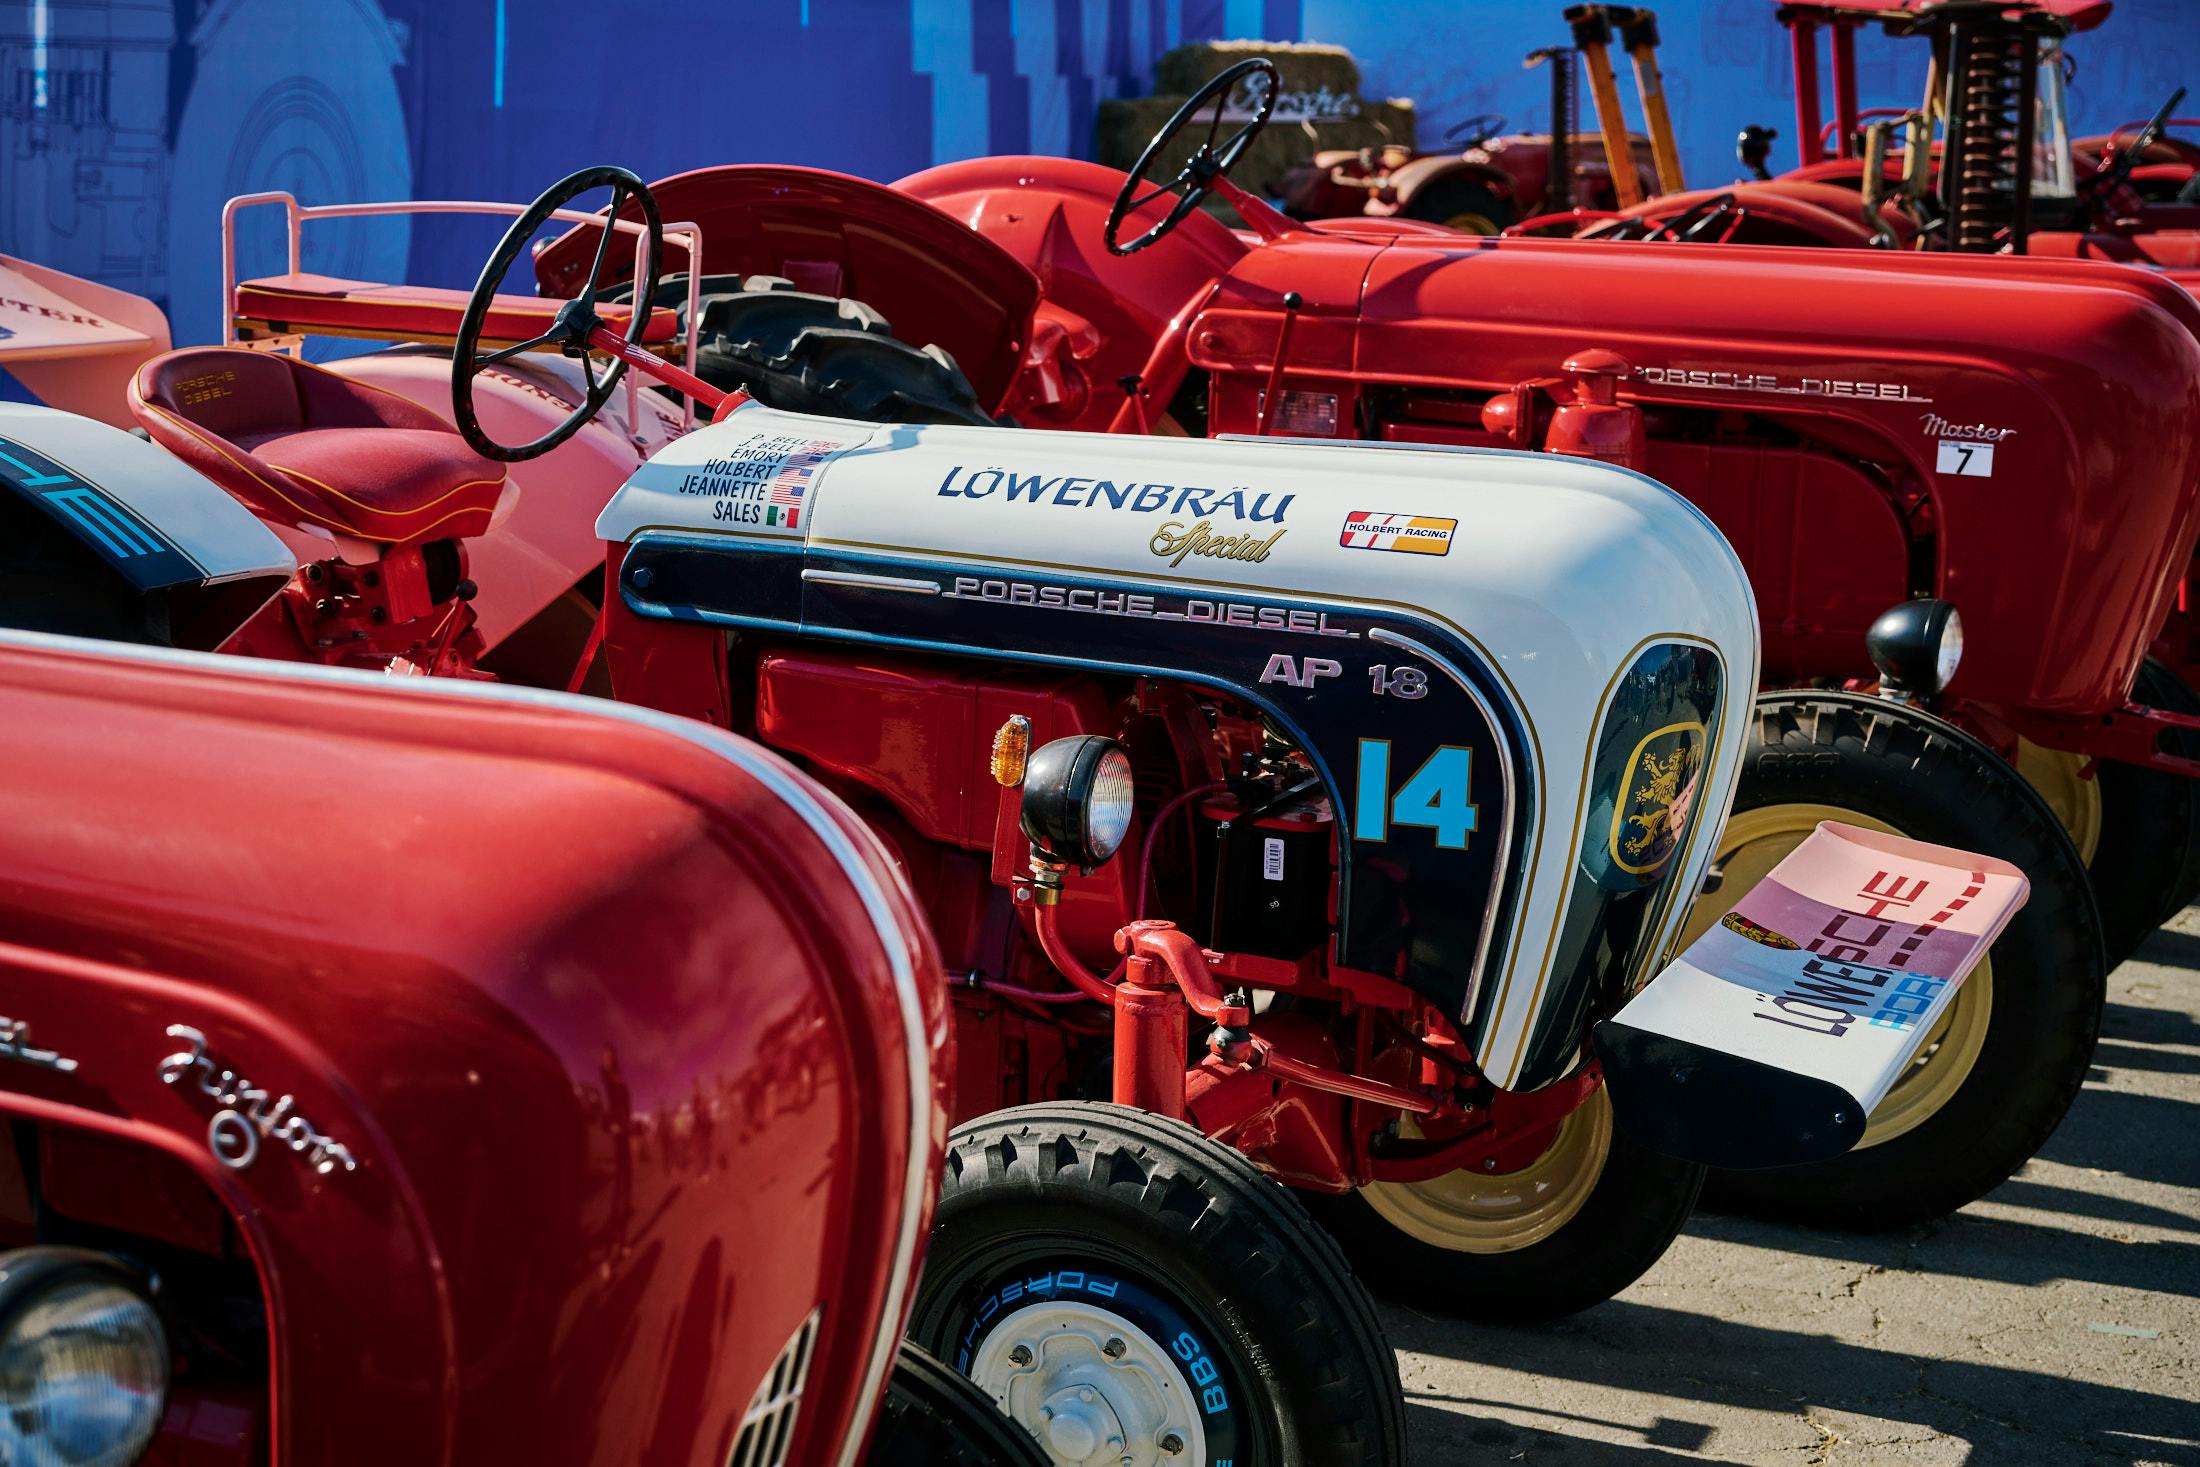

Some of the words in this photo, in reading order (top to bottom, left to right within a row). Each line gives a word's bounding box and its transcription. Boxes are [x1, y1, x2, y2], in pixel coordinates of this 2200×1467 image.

[1801, 378, 1923, 402] DIESEL
[1918, 412, 2018, 441] Master
[757, 442, 795, 452] BELL
[772, 436, 809, 446] BELL
[703, 458, 777, 480] HOLBERT
[731, 448, 790, 464] EMORY
[1957, 447, 1974, 474] 7
[679, 474, 768, 501] JEANNETTE
[937, 466, 1296, 524] LÖWENBRÄU
[712, 500, 761, 524] SALES
[1149, 520, 1288, 568] Special
[1348, 523, 1402, 535] HOLBERT
[1404, 528, 1448, 539] RACING
[954, 576, 1156, 618] PORSCHE
[1187, 600, 1348, 636] DIESEL
[1258, 653, 1343, 689] AP
[1368, 663, 1429, 700] 18
[1352, 736, 1480, 851] 14
[956, 1270, 1119, 1378] PORSCHE
[1171, 1329, 1229, 1416] BBS
